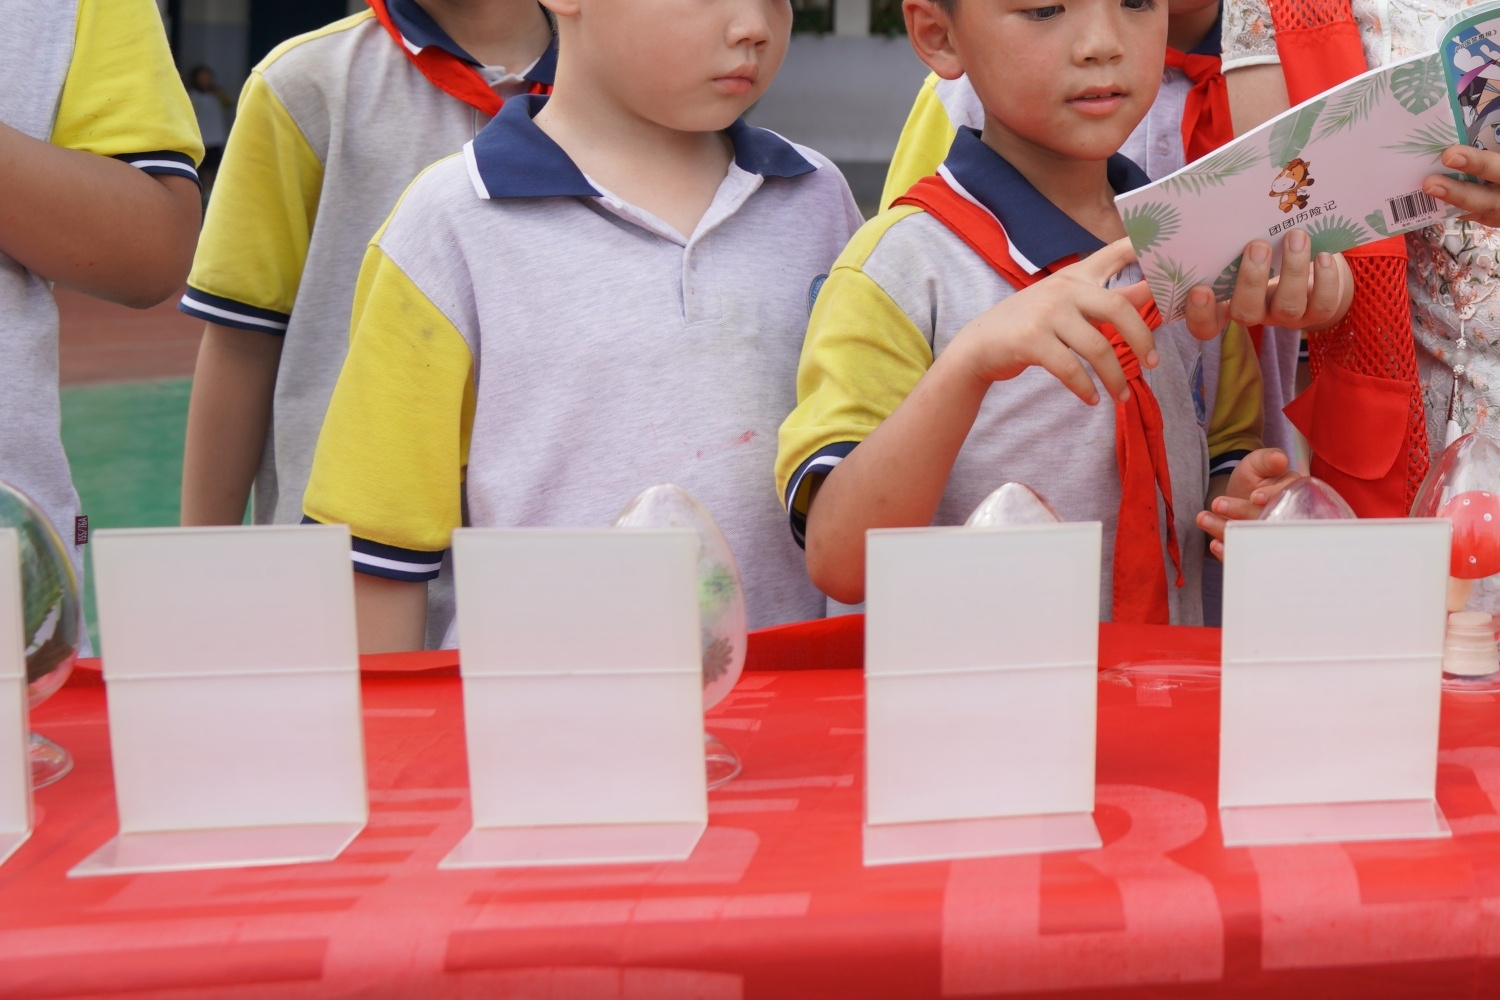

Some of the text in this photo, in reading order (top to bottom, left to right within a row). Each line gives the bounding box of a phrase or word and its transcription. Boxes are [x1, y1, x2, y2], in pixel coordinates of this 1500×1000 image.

[1268, 199, 1338, 237] 团团历险记
